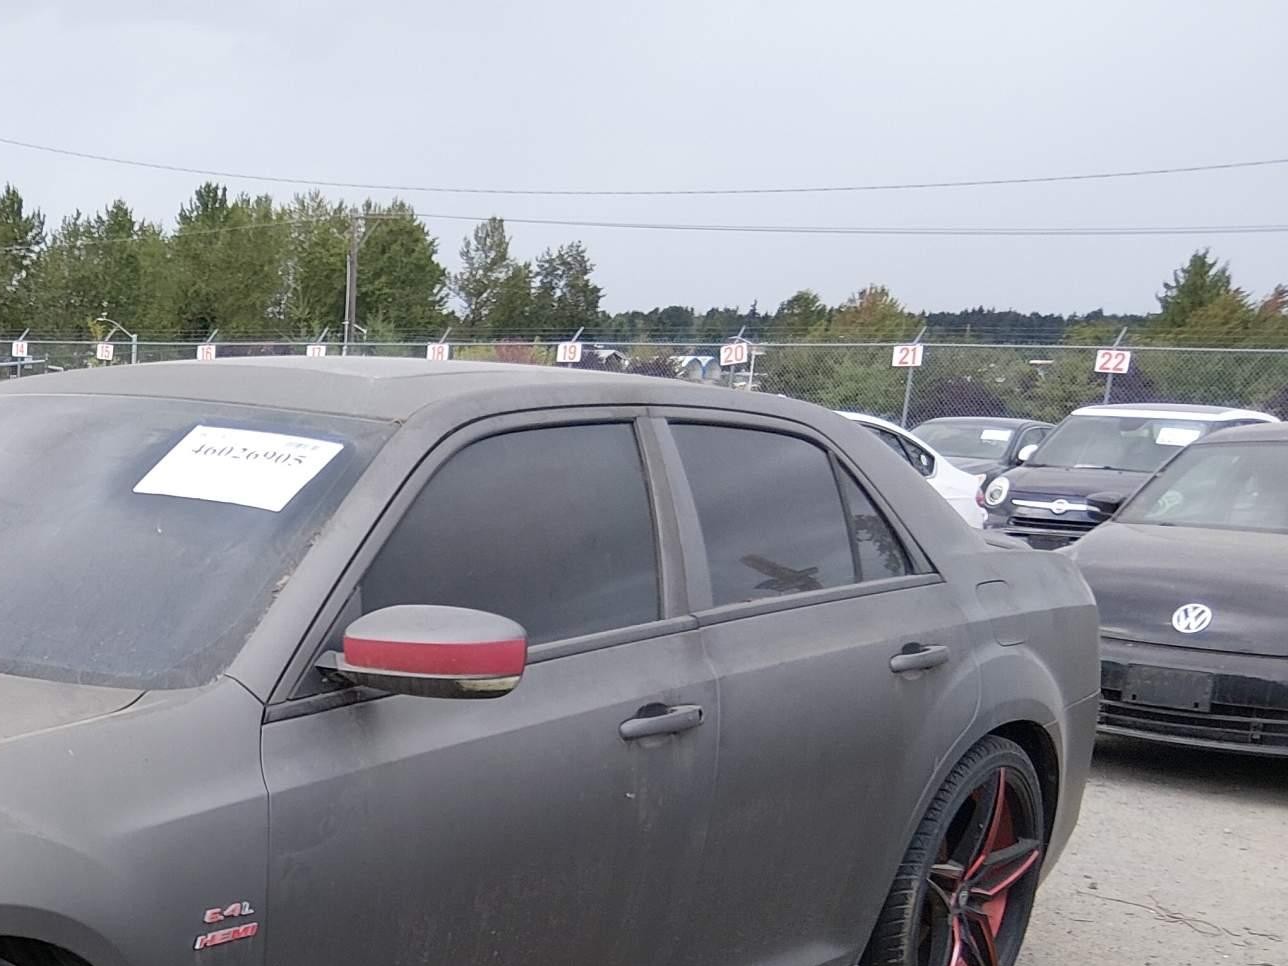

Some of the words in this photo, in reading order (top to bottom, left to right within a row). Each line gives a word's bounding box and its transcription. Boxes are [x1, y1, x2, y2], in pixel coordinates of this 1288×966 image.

[15, 343, 25, 356] 14
[99, 344, 111, 359] 15
[201, 346, 213, 360] 16
[562, 344, 577, 361] 19
[724, 344, 745, 363] 20
[898, 346, 918, 365] 21
[1098, 351, 1126, 371] 22
[1172, 603, 1212, 633] VW
